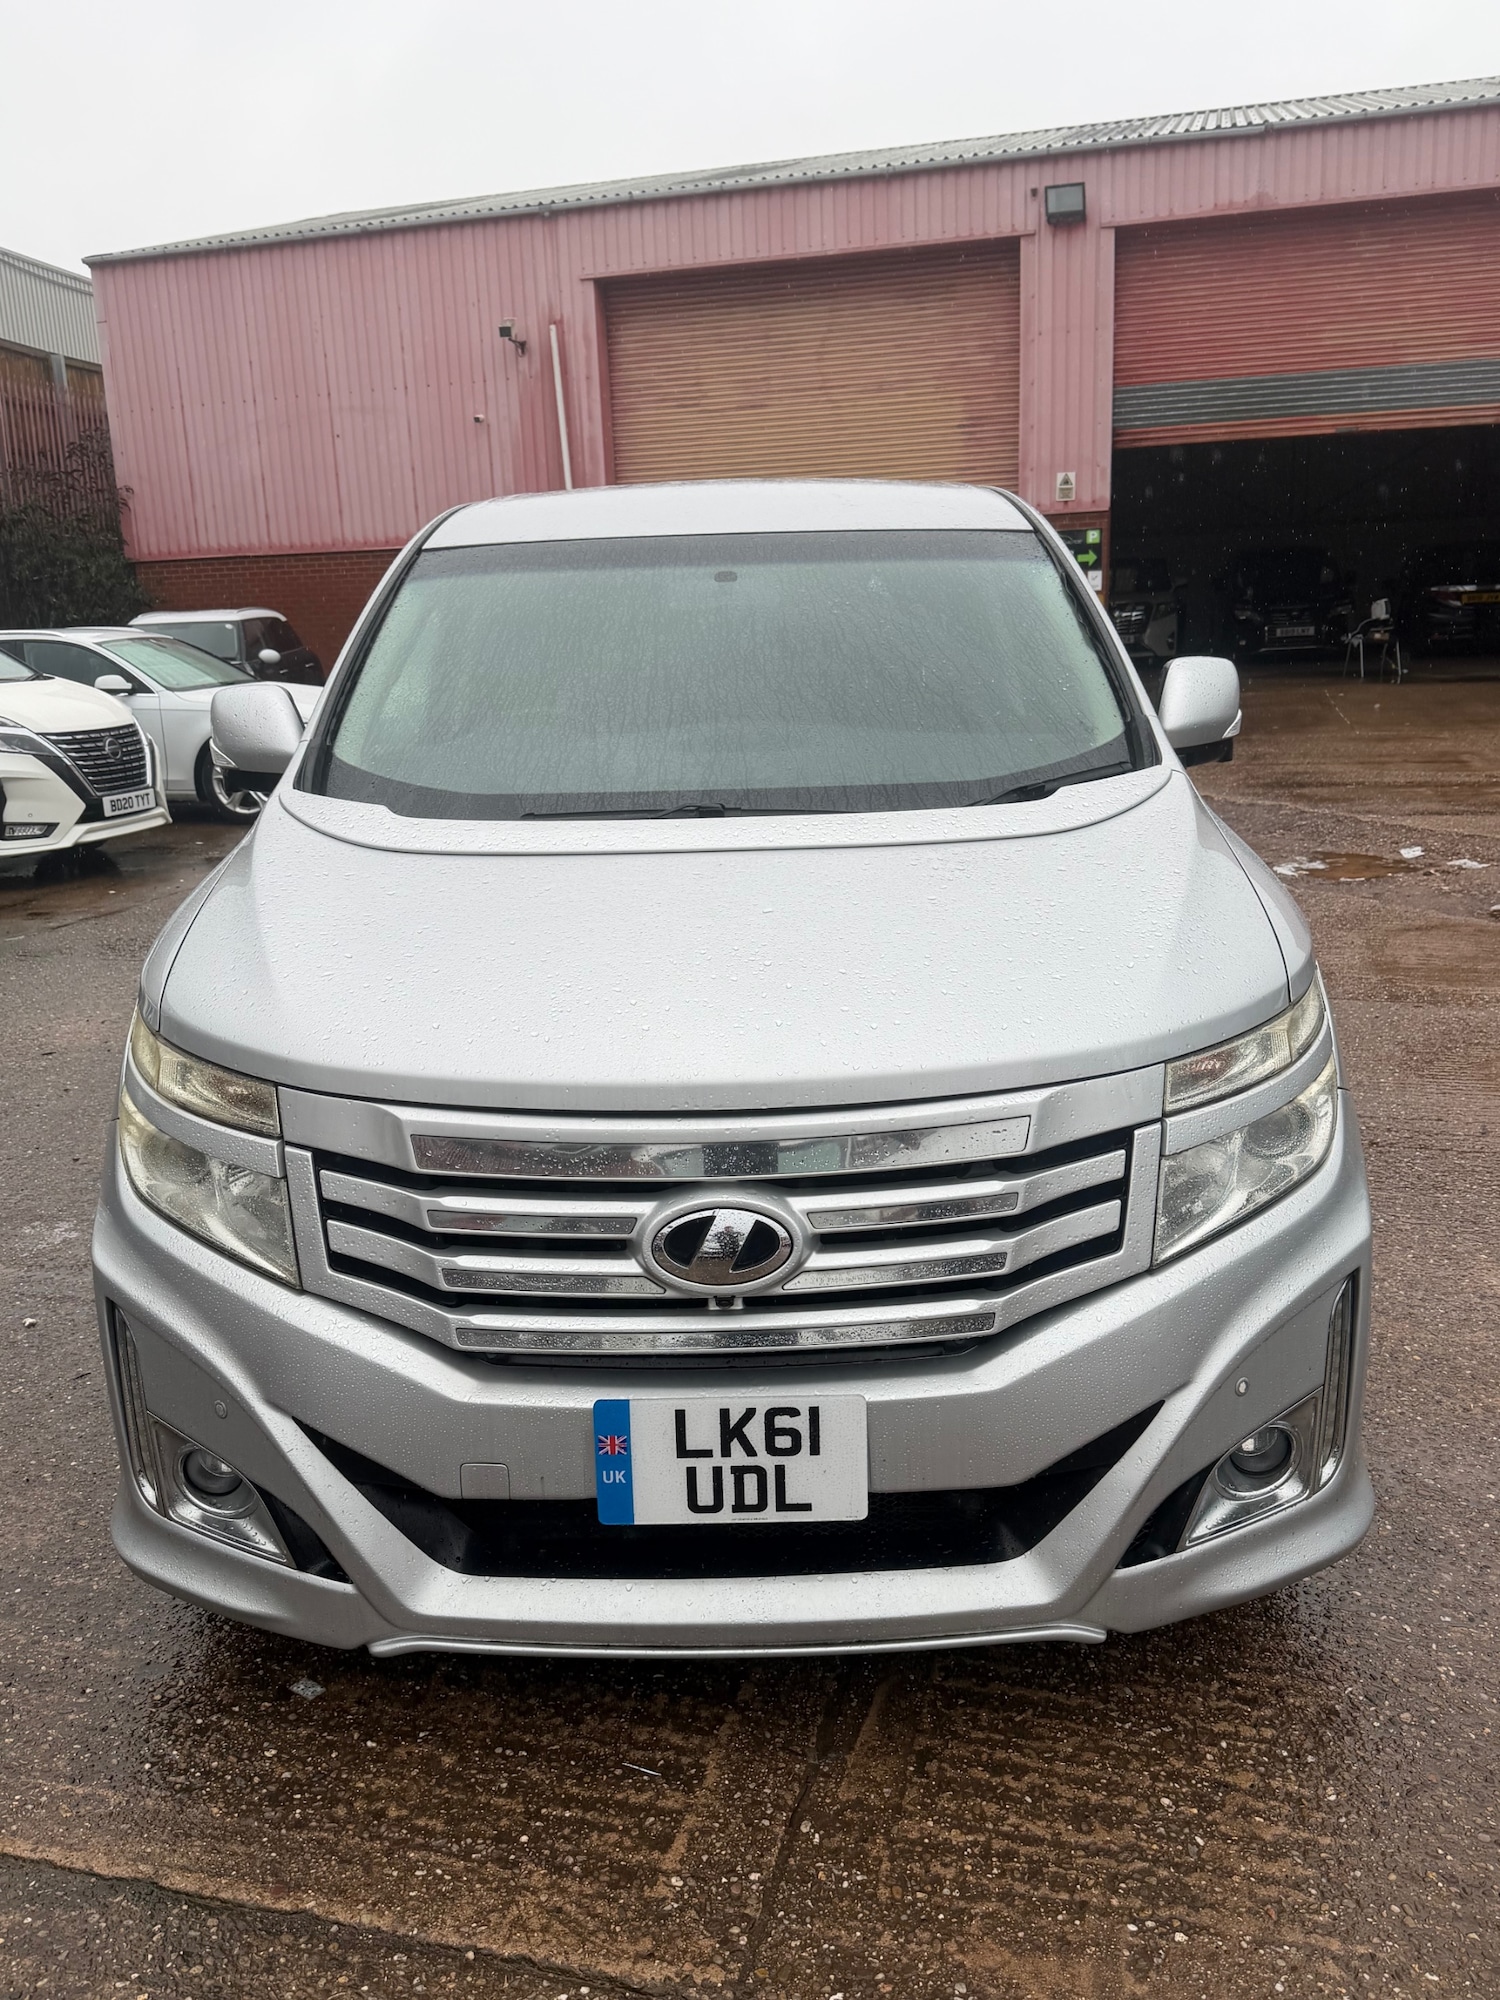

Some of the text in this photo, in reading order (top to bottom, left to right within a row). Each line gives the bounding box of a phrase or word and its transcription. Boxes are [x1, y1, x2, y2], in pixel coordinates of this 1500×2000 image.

[1089, 531, 1098, 543] P
[110, 793, 150, 812] BD20 TYT
[674, 1406, 821, 1459] LK61
[602, 1470, 626, 1484] UK
[686, 1464, 812, 1514] UDL
